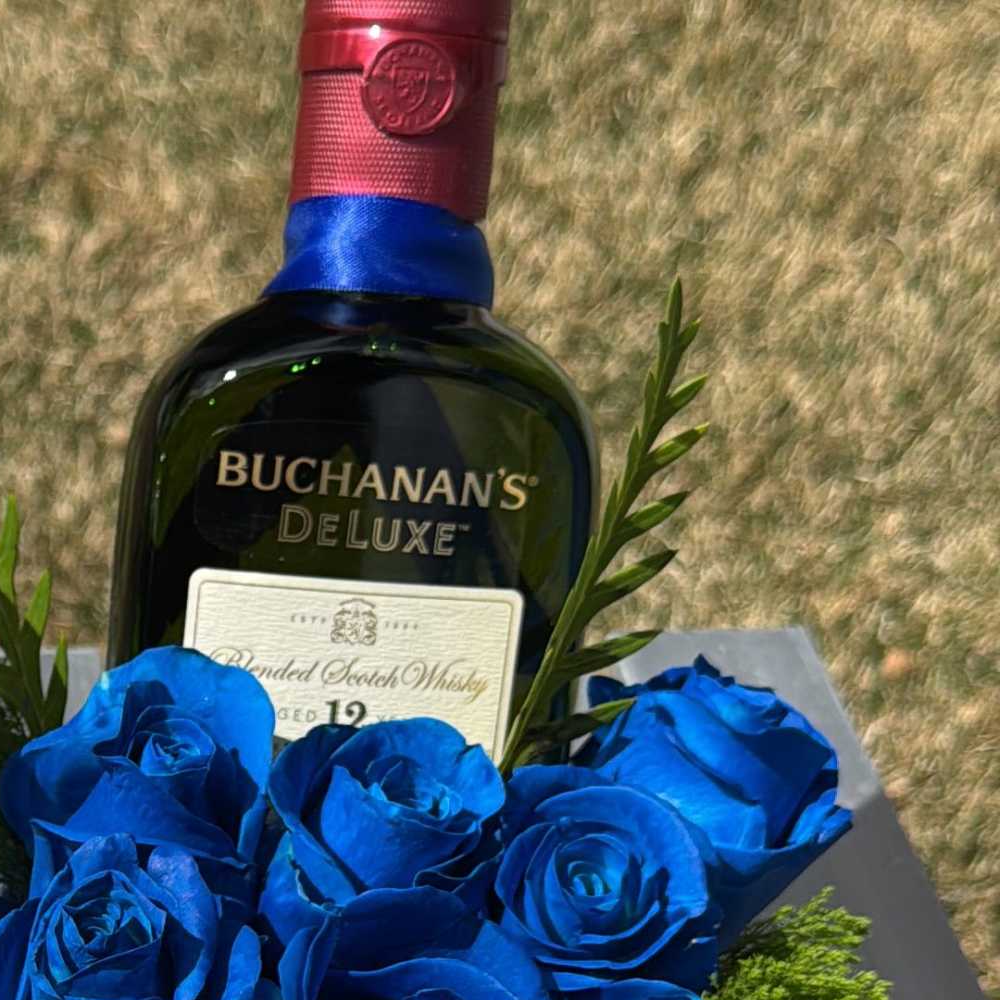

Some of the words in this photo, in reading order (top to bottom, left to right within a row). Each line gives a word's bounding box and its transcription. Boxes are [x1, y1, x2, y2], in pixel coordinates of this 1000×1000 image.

[321, 655, 399, 689] Scotch
[401, 658, 488, 704] Whisky
[277, 707, 318, 723] GED
[326, 699, 367, 727] 12
